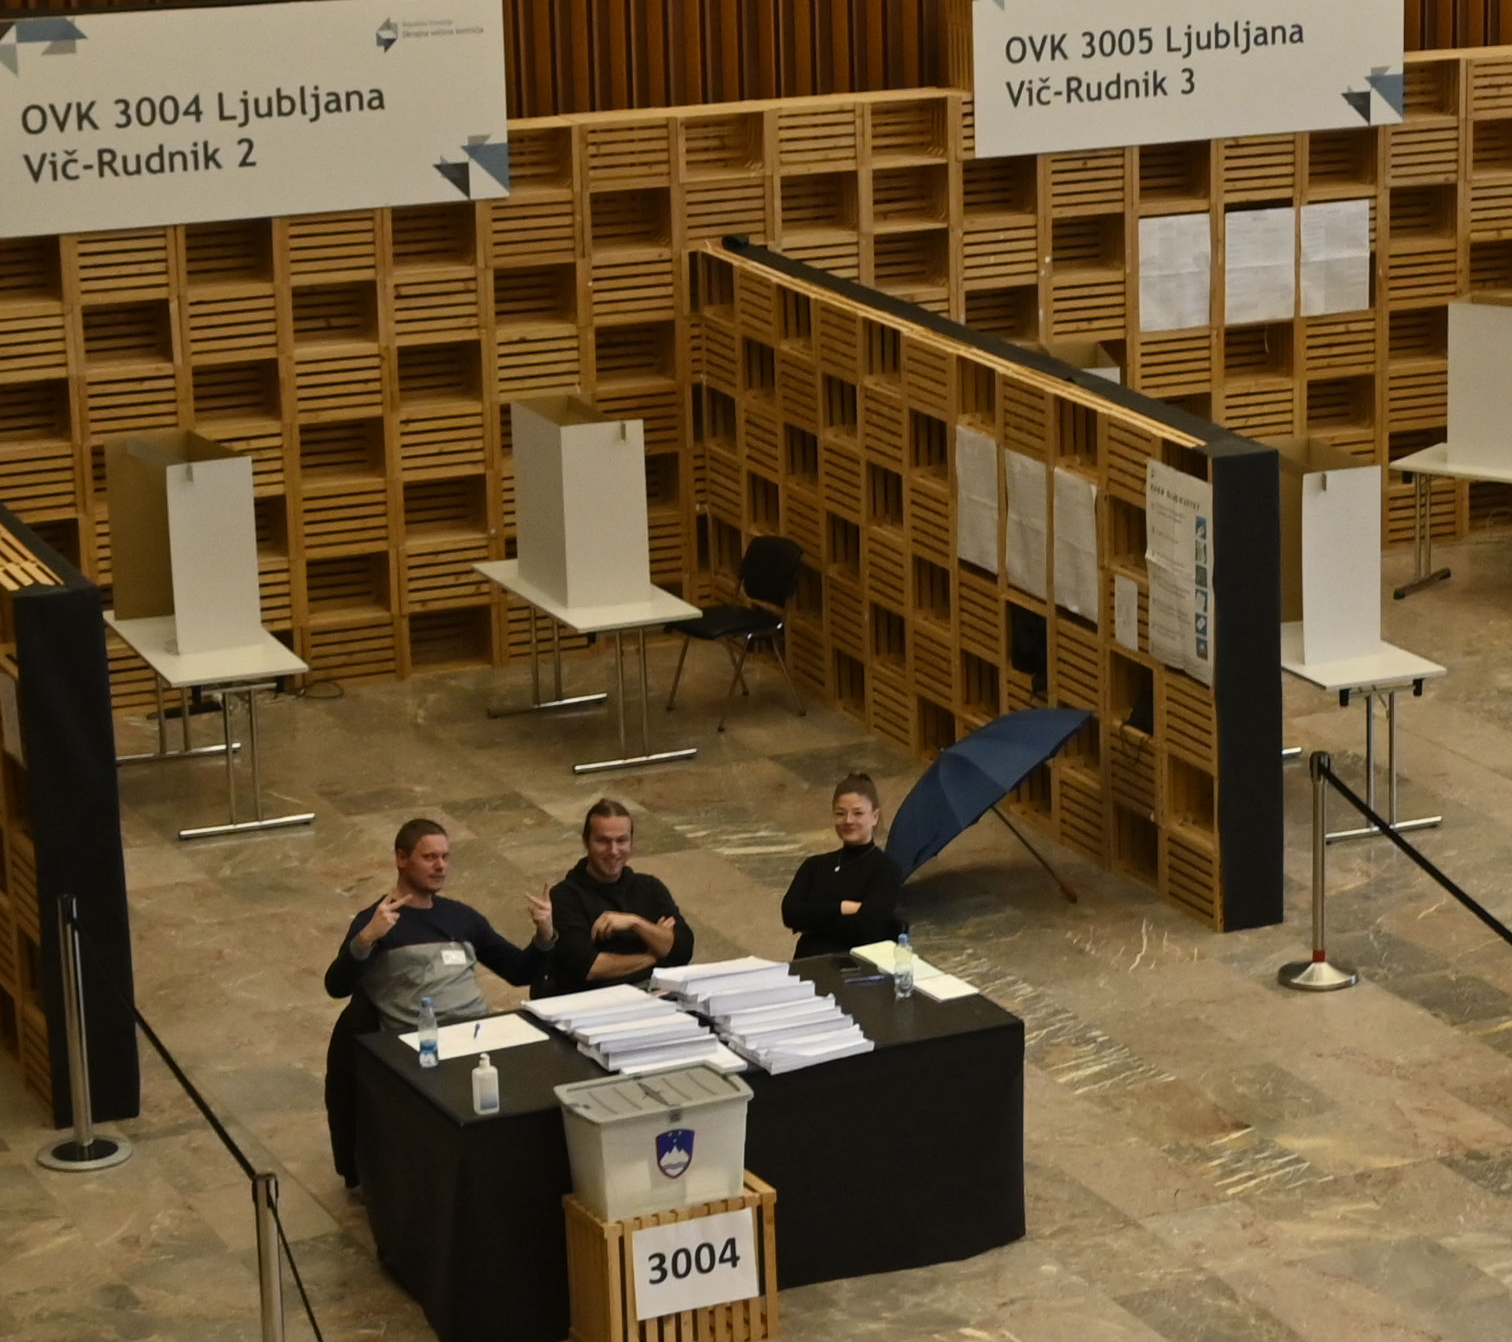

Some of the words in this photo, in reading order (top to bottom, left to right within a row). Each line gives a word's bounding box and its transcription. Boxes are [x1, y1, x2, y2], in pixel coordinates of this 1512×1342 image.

[1005, 33, 1069, 65] OVK
[1081, 27, 1154, 59] 3005
[1166, 20, 1304, 59] Ljubljana
[21, 100, 100, 136] OVK
[114, 93, 204, 129] 3004
[217, 85, 386, 128] Ljubljana
[1005, 69, 1169, 108] Vič-Rudnik
[1180, 67, 1195, 95] 3
[22, 139, 223, 184] Vič-Rudnik
[236, 137, 257, 168] 2
[647, 1236, 741, 1285] 3004
